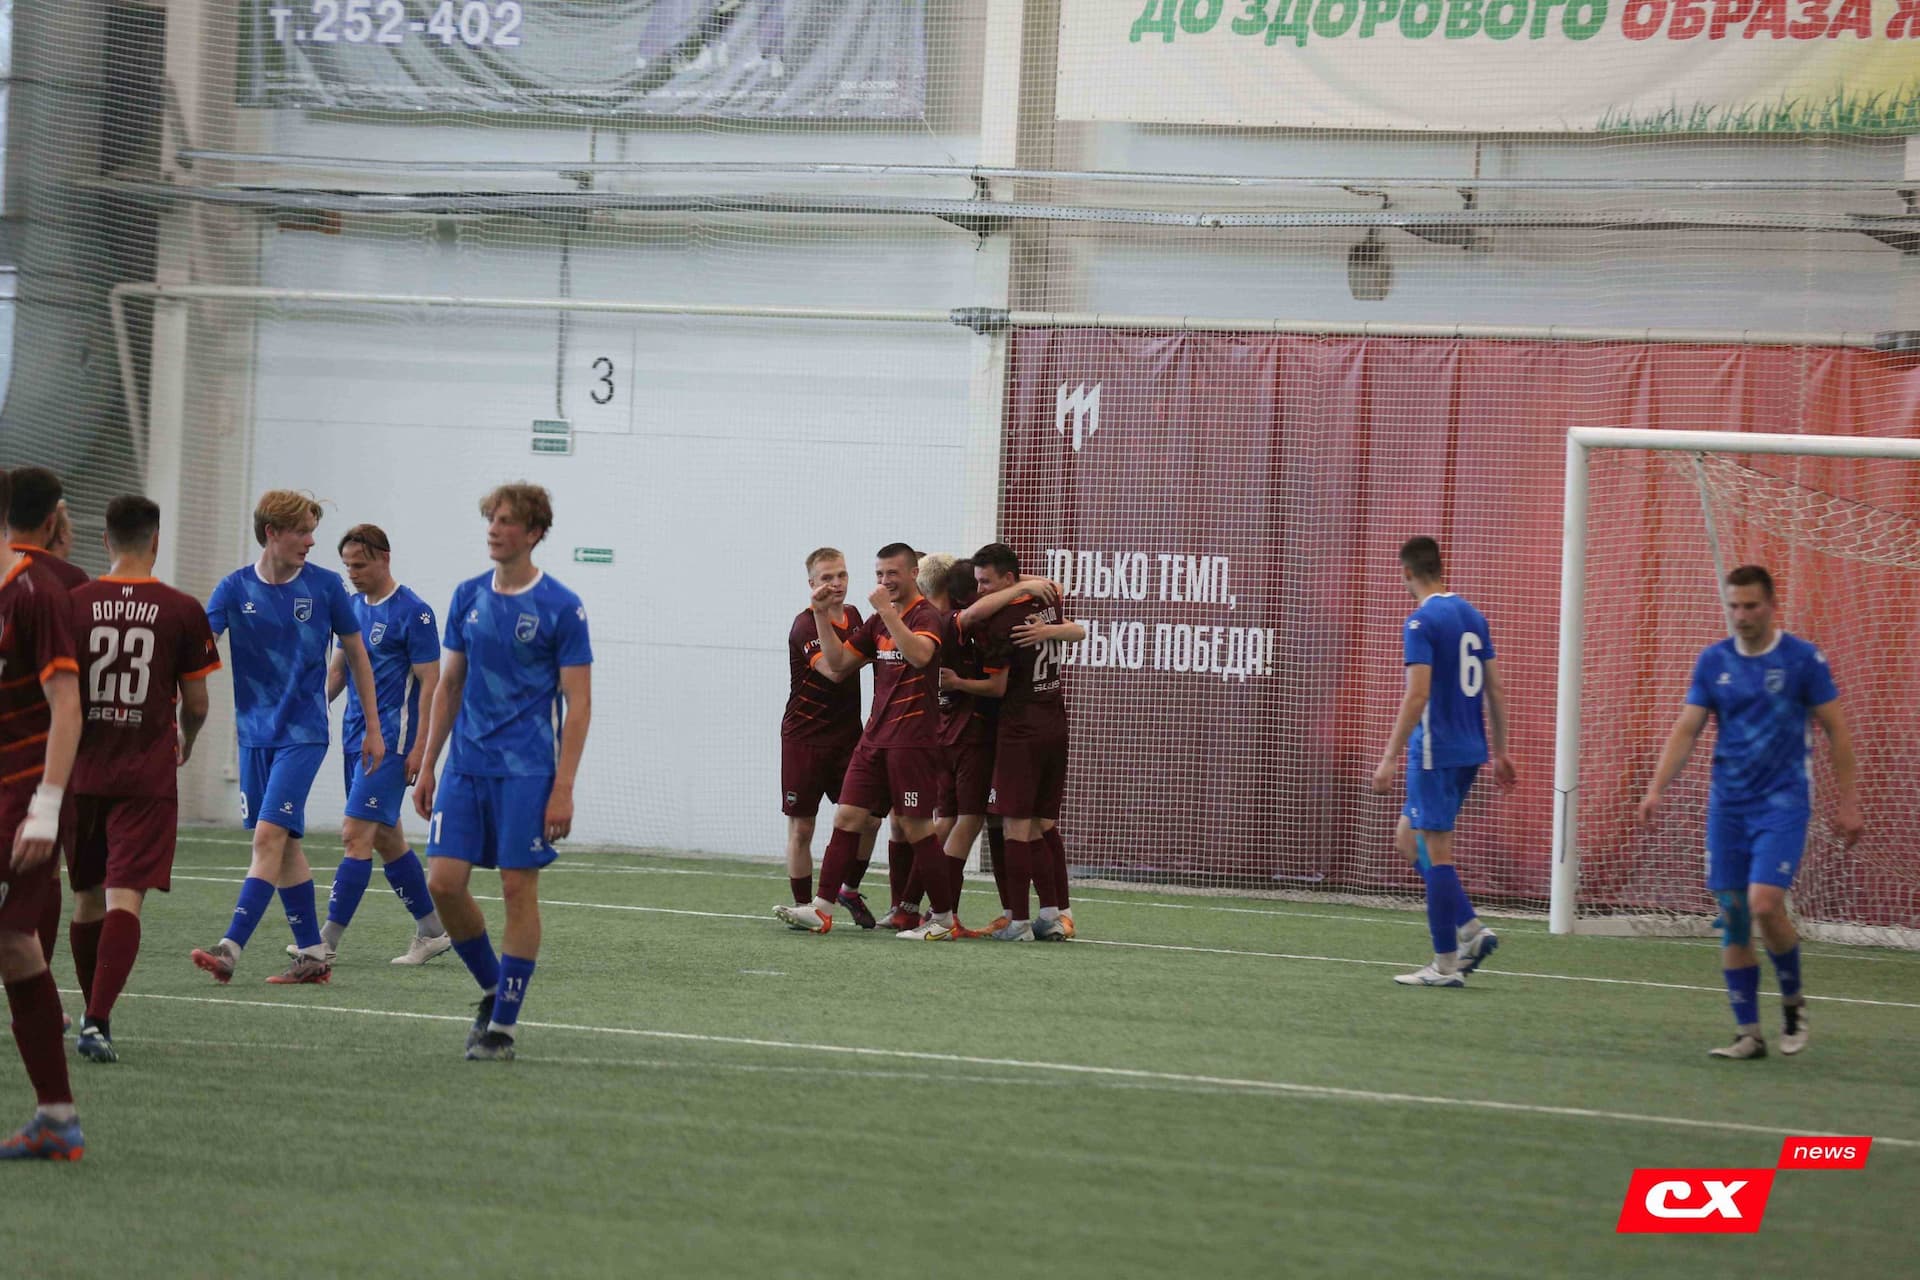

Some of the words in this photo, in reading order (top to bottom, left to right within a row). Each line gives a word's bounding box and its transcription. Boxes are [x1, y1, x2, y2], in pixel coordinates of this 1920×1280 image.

[270, 0, 523, 46] т.252-402
[1129, 0, 1223, 43] ДО
[1230, 0, 1608, 47] ЗДОРОВОГО
[1621, 0, 1872, 41] ОБРАЗА
[590, 356, 614, 405] 3
[1157, 553, 1236, 610] ТЕМП,
[92, 600, 160, 624] ВОРОНА
[88, 625, 156, 706] 23
[1061, 618, 1146, 670] ЛЬКО
[1154, 623, 1275, 683] ПОБЕДА!
[1459, 631, 1484, 697] 6
[87, 706, 143, 723] SEUS
